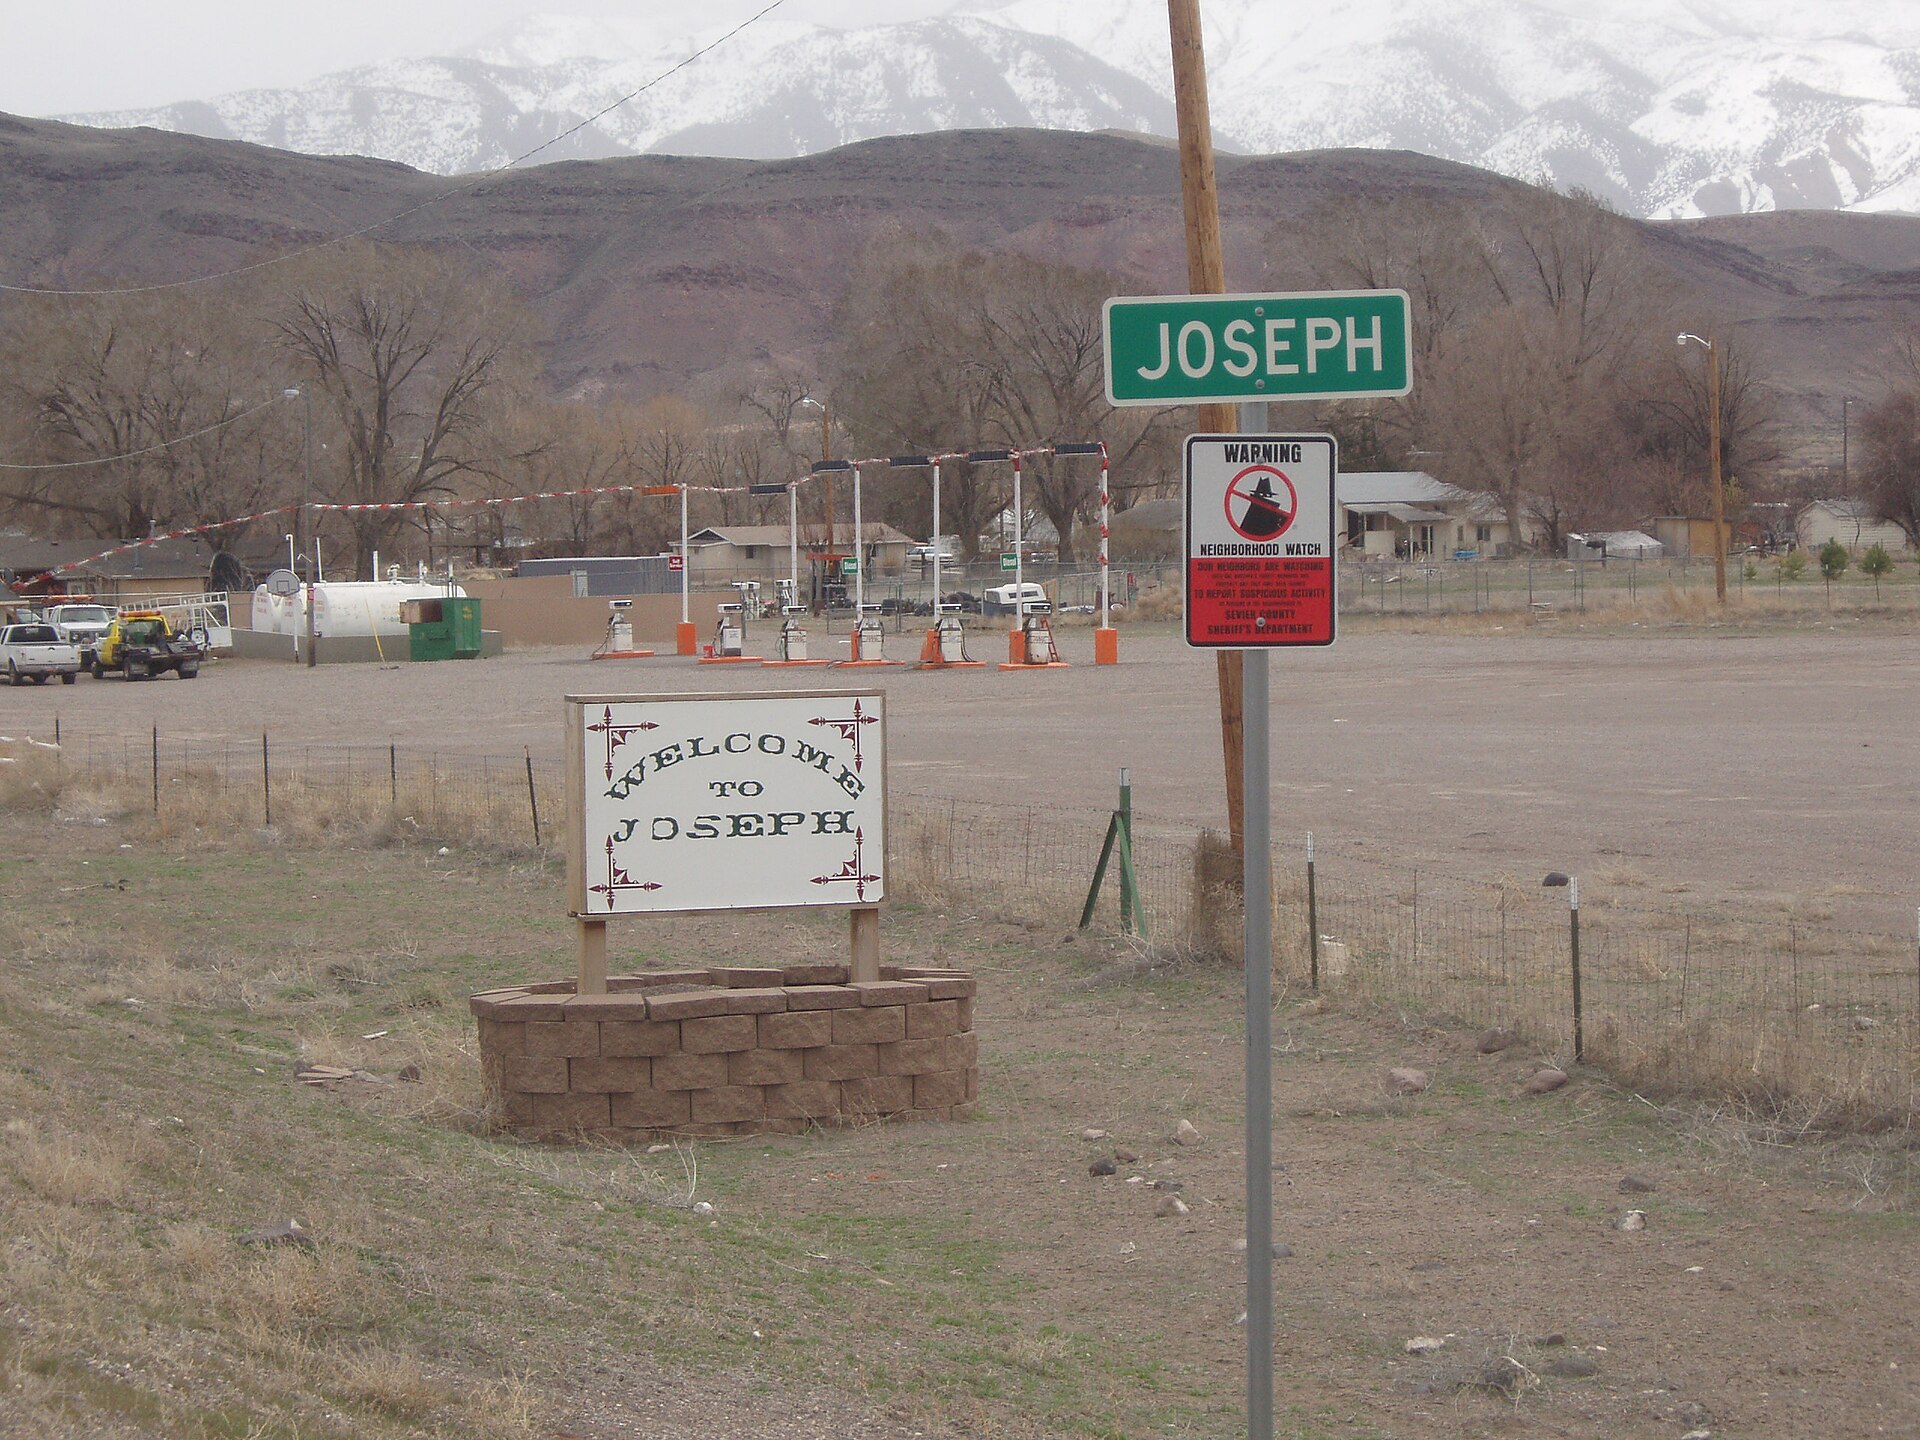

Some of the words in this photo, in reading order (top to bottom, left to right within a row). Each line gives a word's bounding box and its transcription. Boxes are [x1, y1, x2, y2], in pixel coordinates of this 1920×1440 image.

[1137, 316, 1383, 380] JOSEPH
[1224, 443, 1302, 463] WARNING
[1200, 543, 1279, 555] NEIGHBORHOOD
[1286, 543, 1321, 555] WATCH
[1206, 589, 1236, 598] REPORT
[1240, 589, 1287, 598] SUSPICIOUS
[1291, 589, 1326, 598] ACTIVITY
[1260, 609, 1296, 619] COUNTY
[1255, 623, 1313, 634] DEPARTMENT
[604, 732, 866, 800] WELCOME
[709, 781, 764, 797] TO
[612, 810, 855, 843] JOSEPH
